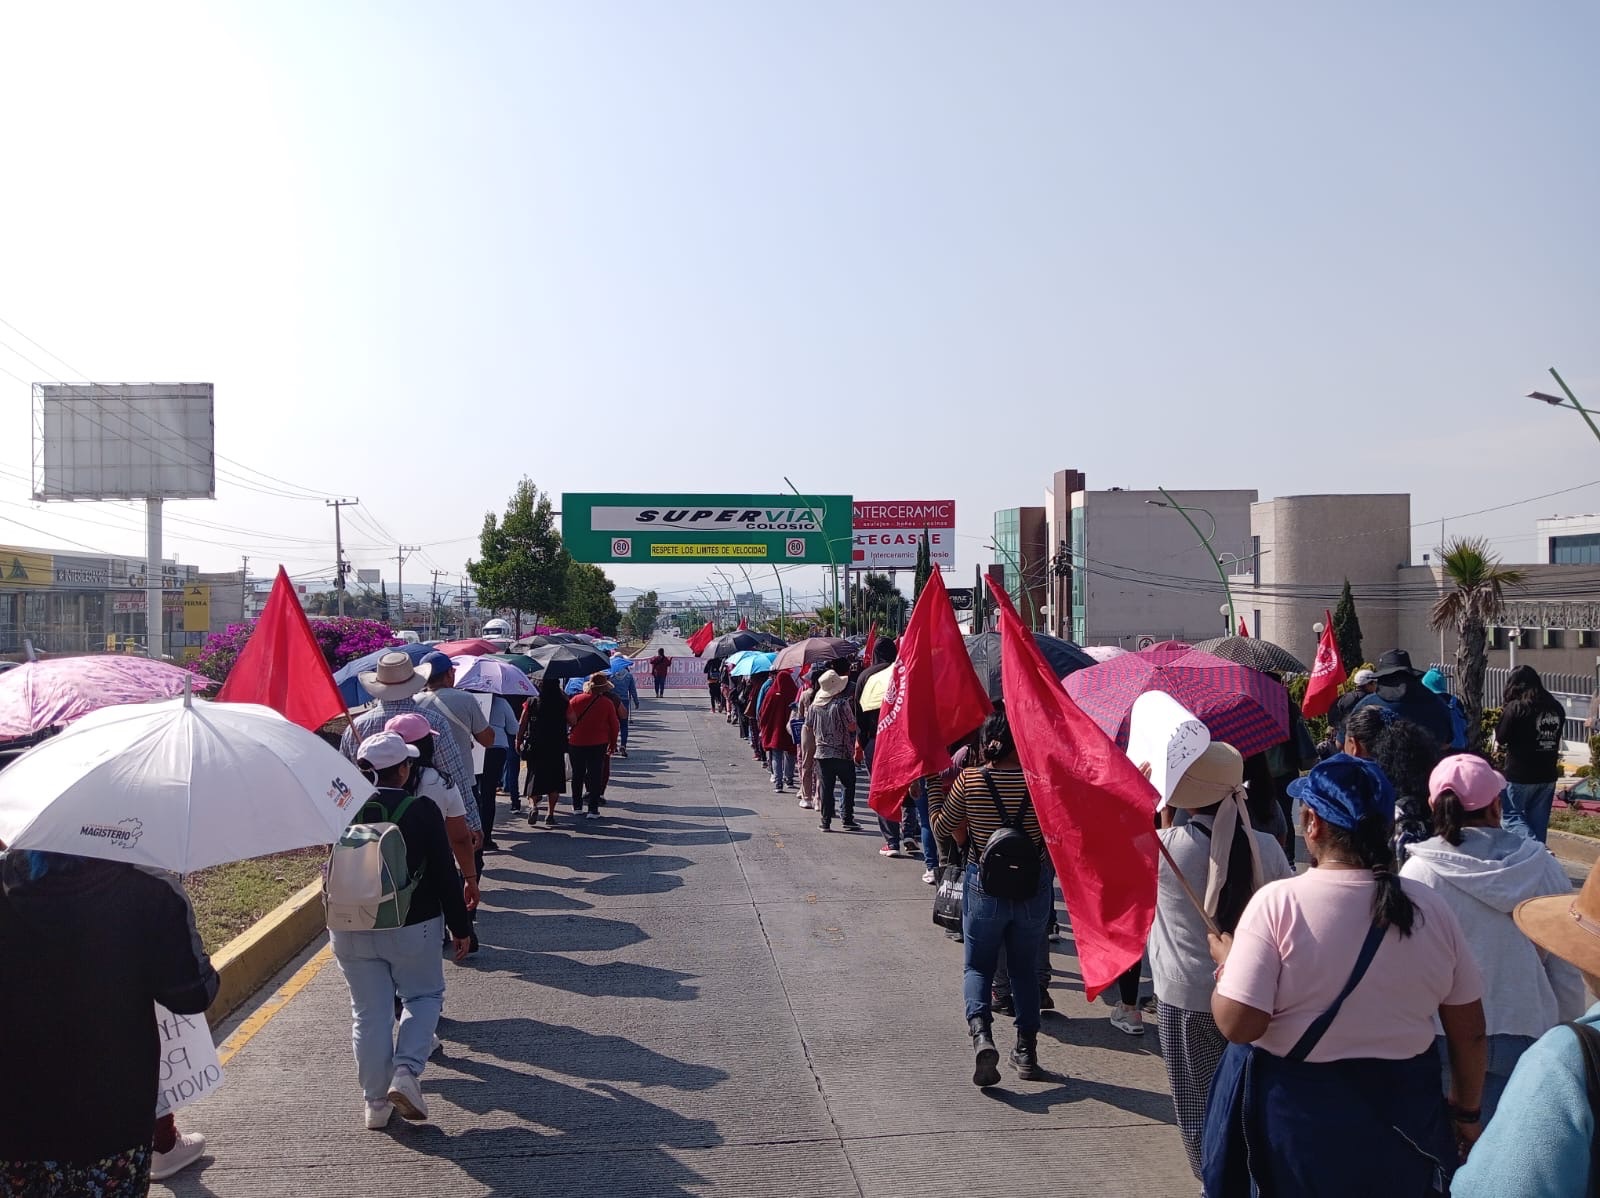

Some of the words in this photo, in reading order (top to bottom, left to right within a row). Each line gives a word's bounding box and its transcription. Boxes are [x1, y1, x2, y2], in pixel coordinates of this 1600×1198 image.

[853, 505, 949, 518] NTERCERAMIC
[616, 542, 627, 551] 80
[651, 546, 679, 554] RESPETE
[682, 546, 694, 554] LOS
[721, 546, 731, 554] DE
[732, 546, 766, 554] VELOCIDAD
[791, 542, 801, 551] 80
[870, 551, 915, 559] Interceramic
[80, 826, 131, 841] MAGISTERIO
